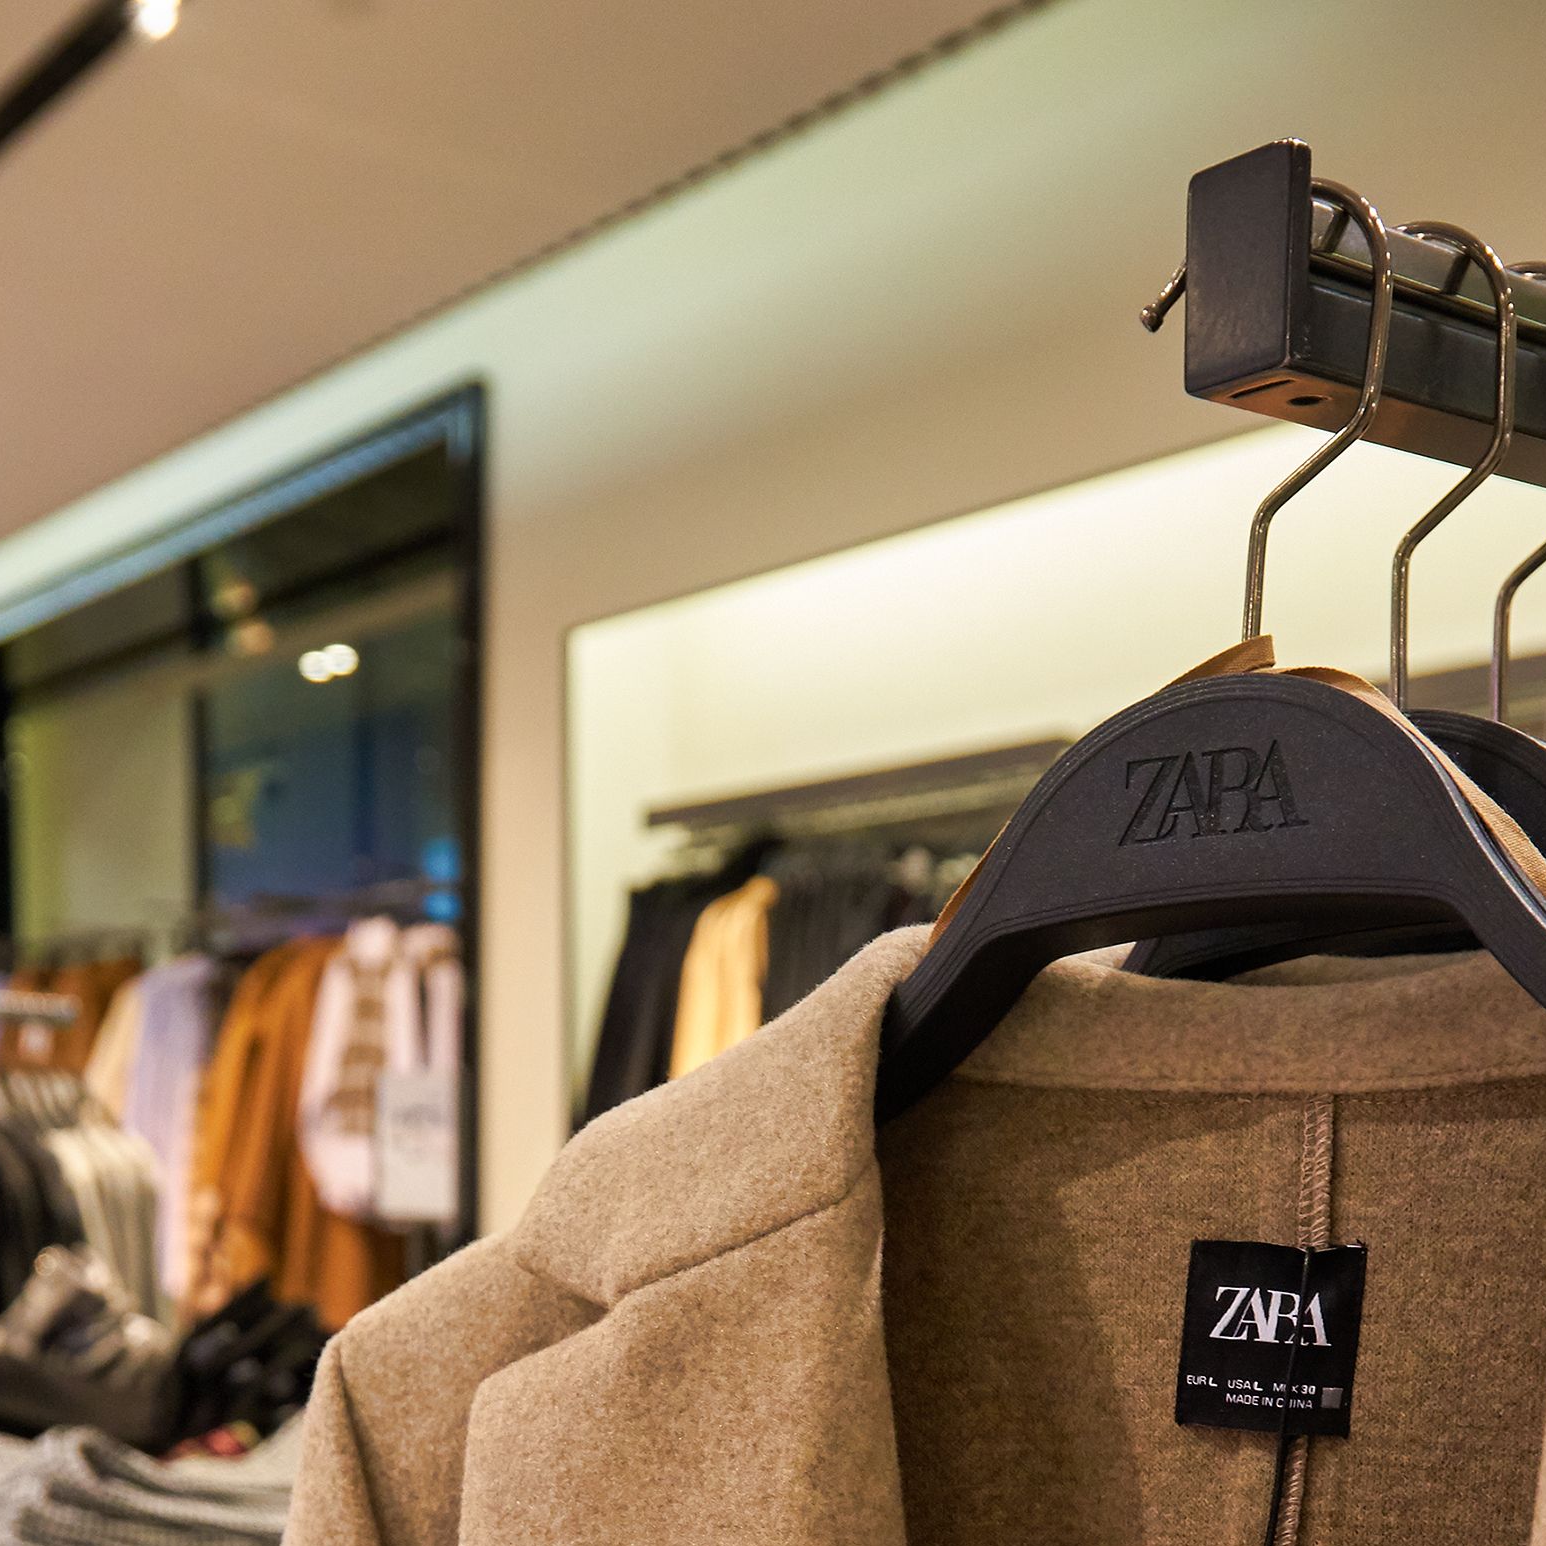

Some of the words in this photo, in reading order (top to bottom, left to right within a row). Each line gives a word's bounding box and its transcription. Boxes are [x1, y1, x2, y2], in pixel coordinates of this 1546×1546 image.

[1118, 739, 1309, 846] ZARA
[1209, 1286, 1332, 1347] ZARA
[1186, 1374, 1207, 1386] EUR
[1208, 1377, 1218, 1387] L
[1227, 1379, 1252, 1390] USA
[1253, 1381, 1263, 1392] L
[1300, 1384, 1316, 1395] 30
[1225, 1393, 1259, 1406] MADE
[1261, 1396, 1273, 1407] IN
